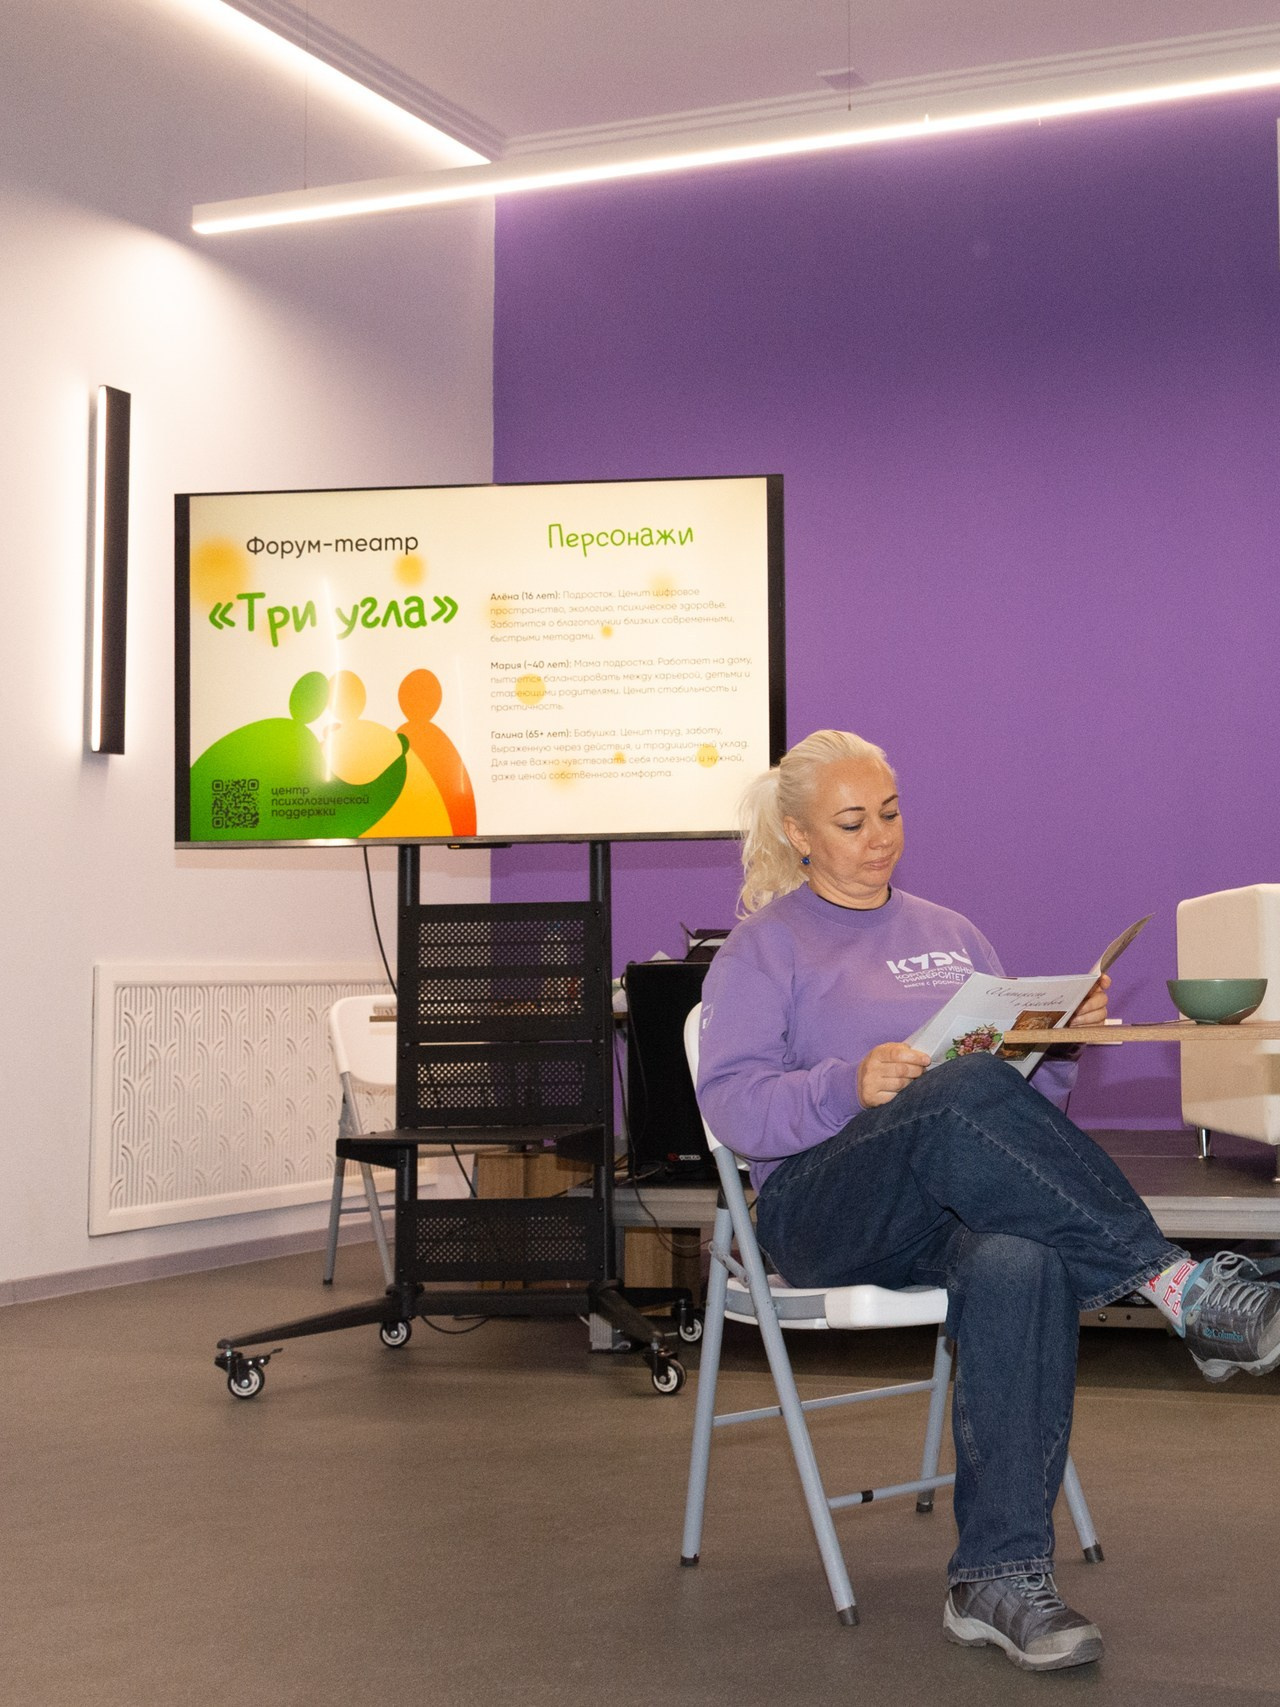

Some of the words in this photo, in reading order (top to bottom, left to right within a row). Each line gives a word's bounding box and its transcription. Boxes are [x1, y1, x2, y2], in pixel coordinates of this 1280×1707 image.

[246, 535, 418, 559] Форум-театр
[548, 523, 694, 557] Персонажи
[490, 592, 519, 601] Алёна
[521, 590, 534, 600] (16
[536, 590, 561, 600] лет):
[562, 590, 616, 600] Подросток.
[618, 589, 650, 599] Ценит
[652, 587, 700, 598] цифровое
[490, 606, 567, 616] пространство,
[617, 602, 677, 612] психическое
[208, 591, 317, 648] «Три
[335, 594, 459, 640] угла»
[490, 619, 546, 629] Заботится
[556, 617, 621, 627] благополучии
[623, 616, 659, 626] близких
[490, 634, 540, 643] быстрыми
[542, 632, 595, 643] методами.
[490, 661, 522, 671] Мария
[547, 659, 572, 669] лет):
[574, 659, 601, 668] Мама
[657, 656, 711, 666] Работает
[712, 657, 725, 665] на
[490, 675, 541, 684] пытается
[543, 673, 621, 683] балансировать
[622, 673, 653, 682] между
[704, 670, 743, 680] детьми
[490, 689, 557, 699] стареющими
[558, 687, 621, 698] родителями.
[623, 685, 656, 695] Ценит
[657, 684, 730, 694] стабильность
[490, 730, 523, 739] Галина
[546, 729, 572, 738] лет):
[620, 727, 653, 737] Ценит
[491, 744, 551, 754] выраженную
[553, 744, 581, 753] через
[643, 740, 717, 751] традиционный
[491, 758, 508, 768] Для
[510, 758, 528, 767] нее
[529, 757, 560, 767] важно
[562, 755, 626, 767] чувствовать
[628, 754, 651, 764] себя
[652, 752, 697, 764] полезной
[490, 773, 516, 782] даже
[518, 772, 547, 781] ценой
[548, 769, 619, 780] собственного
[271, 786, 310, 797] центр
[271, 795, 370, 807] психологической
[271, 808, 336, 819] поддержки
